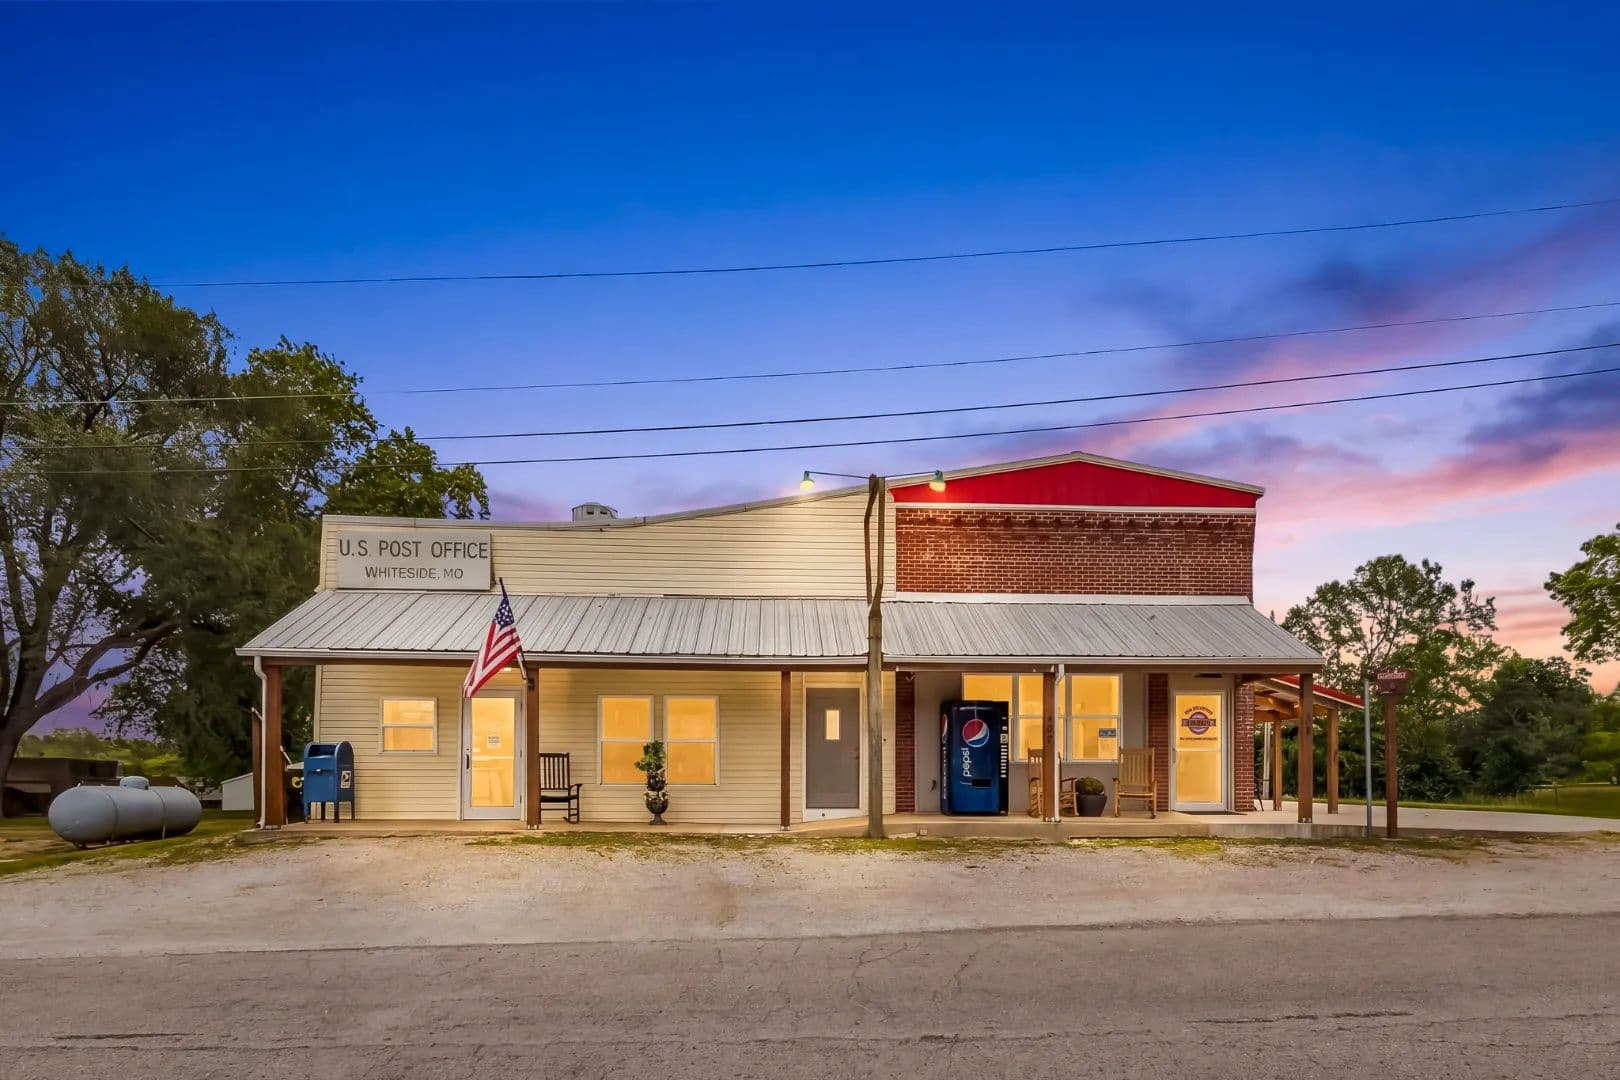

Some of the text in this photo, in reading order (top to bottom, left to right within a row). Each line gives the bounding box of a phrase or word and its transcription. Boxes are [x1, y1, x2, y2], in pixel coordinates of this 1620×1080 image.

[339, 539, 489, 559] U.S. POST OFFICE
[365, 566, 464, 581] WHITESIDE, MO
[961, 747, 972, 777] pepsi
